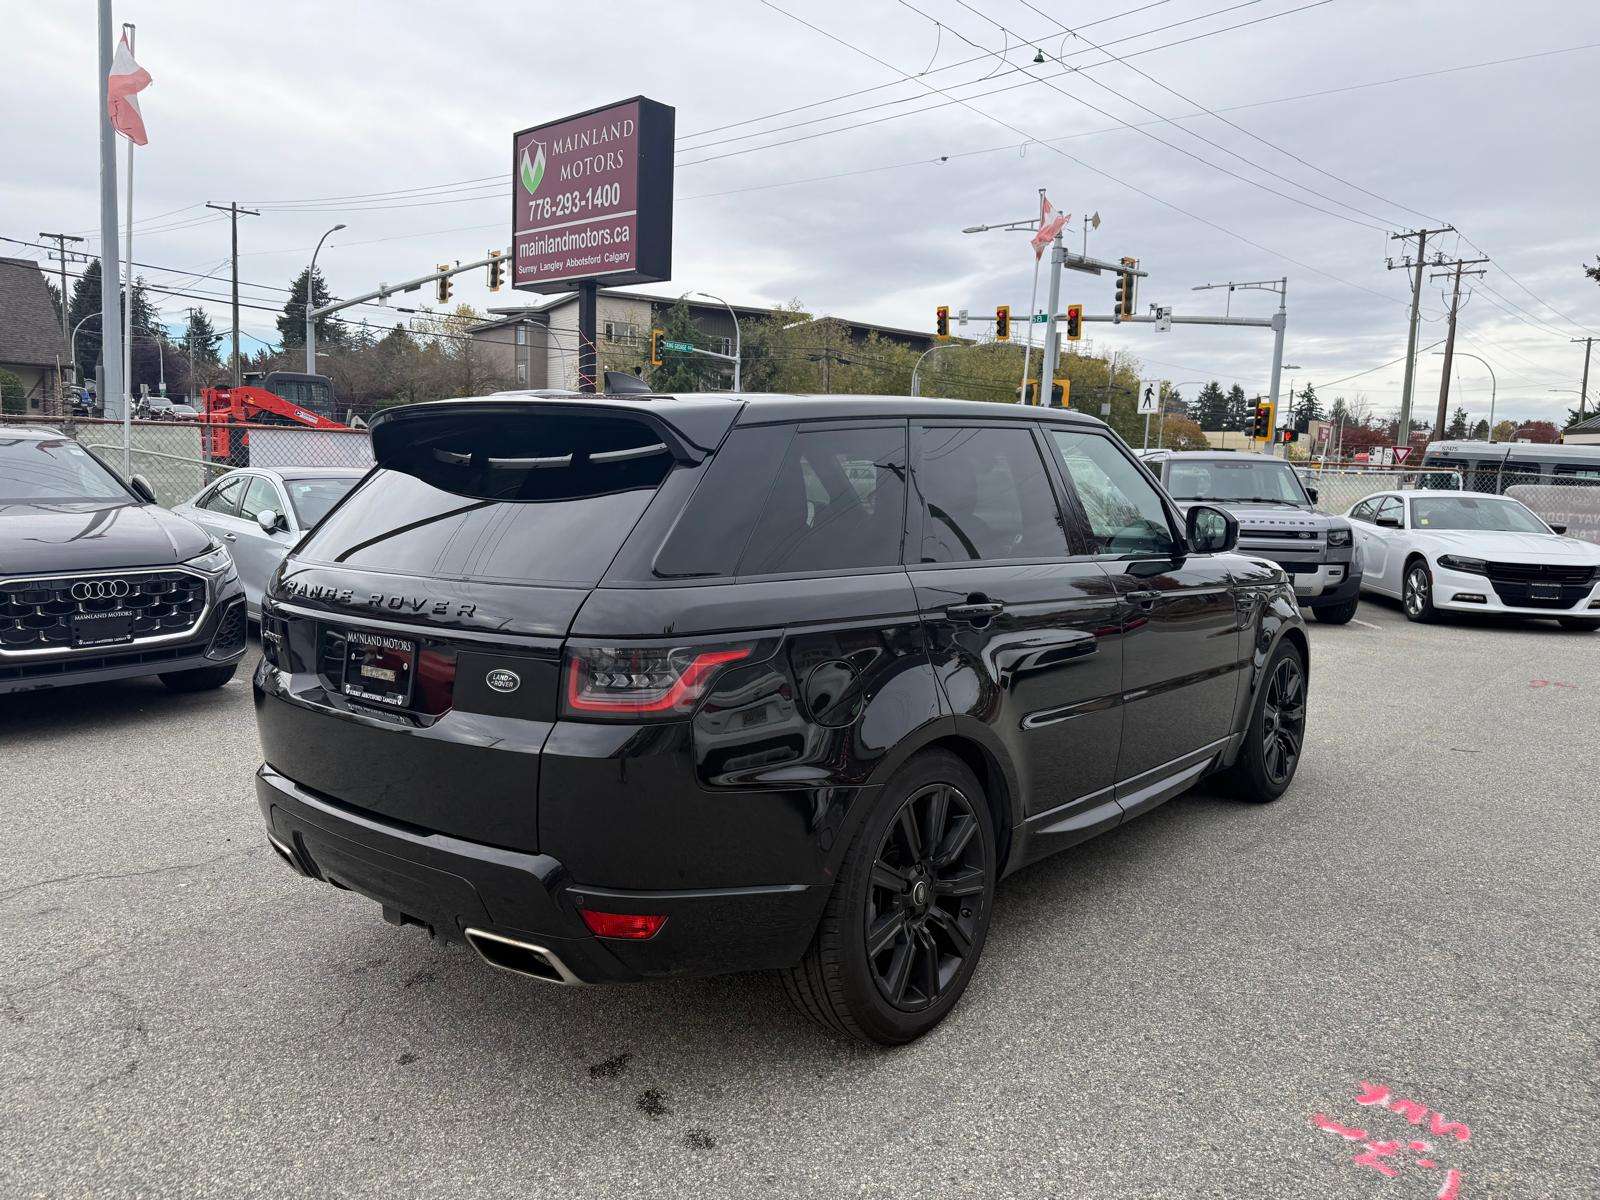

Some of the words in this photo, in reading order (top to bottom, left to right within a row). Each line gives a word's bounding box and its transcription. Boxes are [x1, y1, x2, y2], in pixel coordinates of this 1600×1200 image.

[552, 119, 634, 156] MAINLAND
[560, 149, 624, 181] MOTORS
[528, 182, 621, 222] 778-293-1400
[519, 225, 630, 258] mainlandmotors.ca
[518, 265, 538, 275] Surrey
[540, 260, 564, 271] Langley
[566, 255, 601, 268] Abbotsford
[604, 251, 630, 264] Calgary
[287, 580, 354, 603] RANGE
[368, 594, 477, 618] ROVER
[75, 613, 107, 621] MAINLAND
[108, 610, 133, 618] MOTORS
[347, 632, 382, 647] MAINLAND
[383, 637, 411, 652] MOTORS
[493, 673, 509, 681] LAND
[494, 680, 514, 688] ROVER
